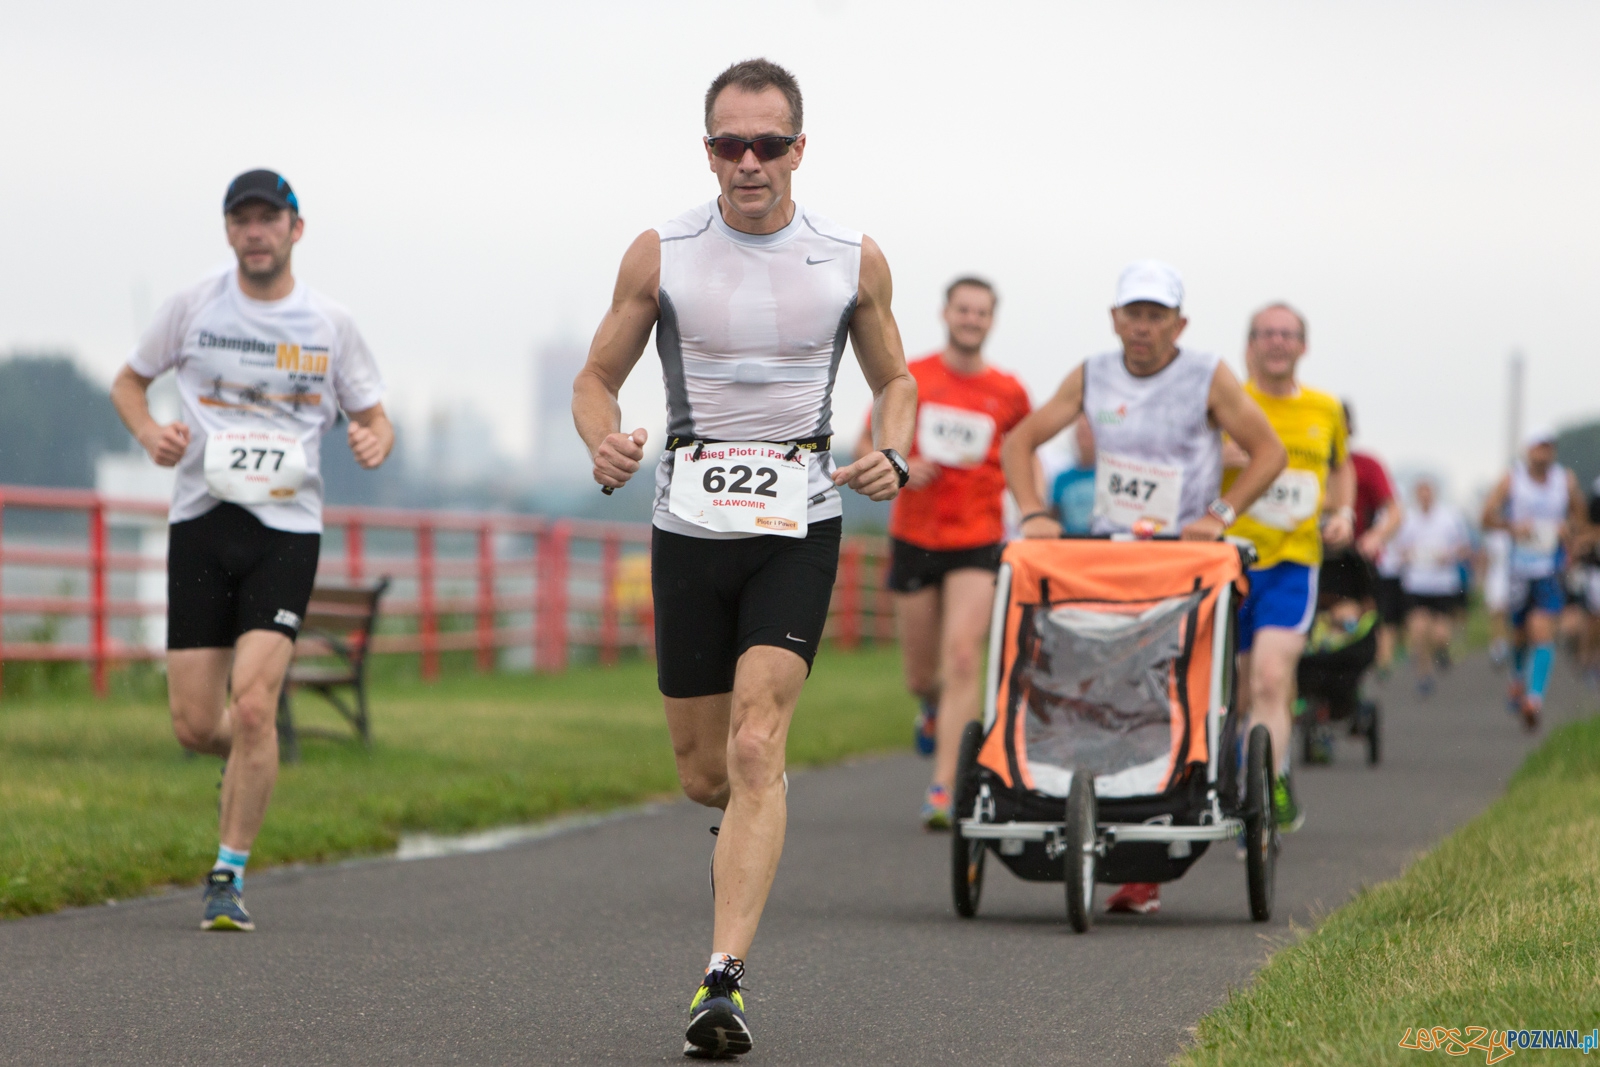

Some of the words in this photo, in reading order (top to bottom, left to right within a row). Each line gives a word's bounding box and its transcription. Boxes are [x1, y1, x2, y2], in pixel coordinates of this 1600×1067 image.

[276, 342, 328, 375] Man
[230, 447, 285, 472] 277
[700, 450, 725, 460] Bieg
[728, 447, 757, 457] Piotr
[760, 447, 764, 457] i
[702, 465, 778, 498] 622
[1108, 473, 1158, 502] 847
[712, 499, 766, 510] SŁAWOMIR
